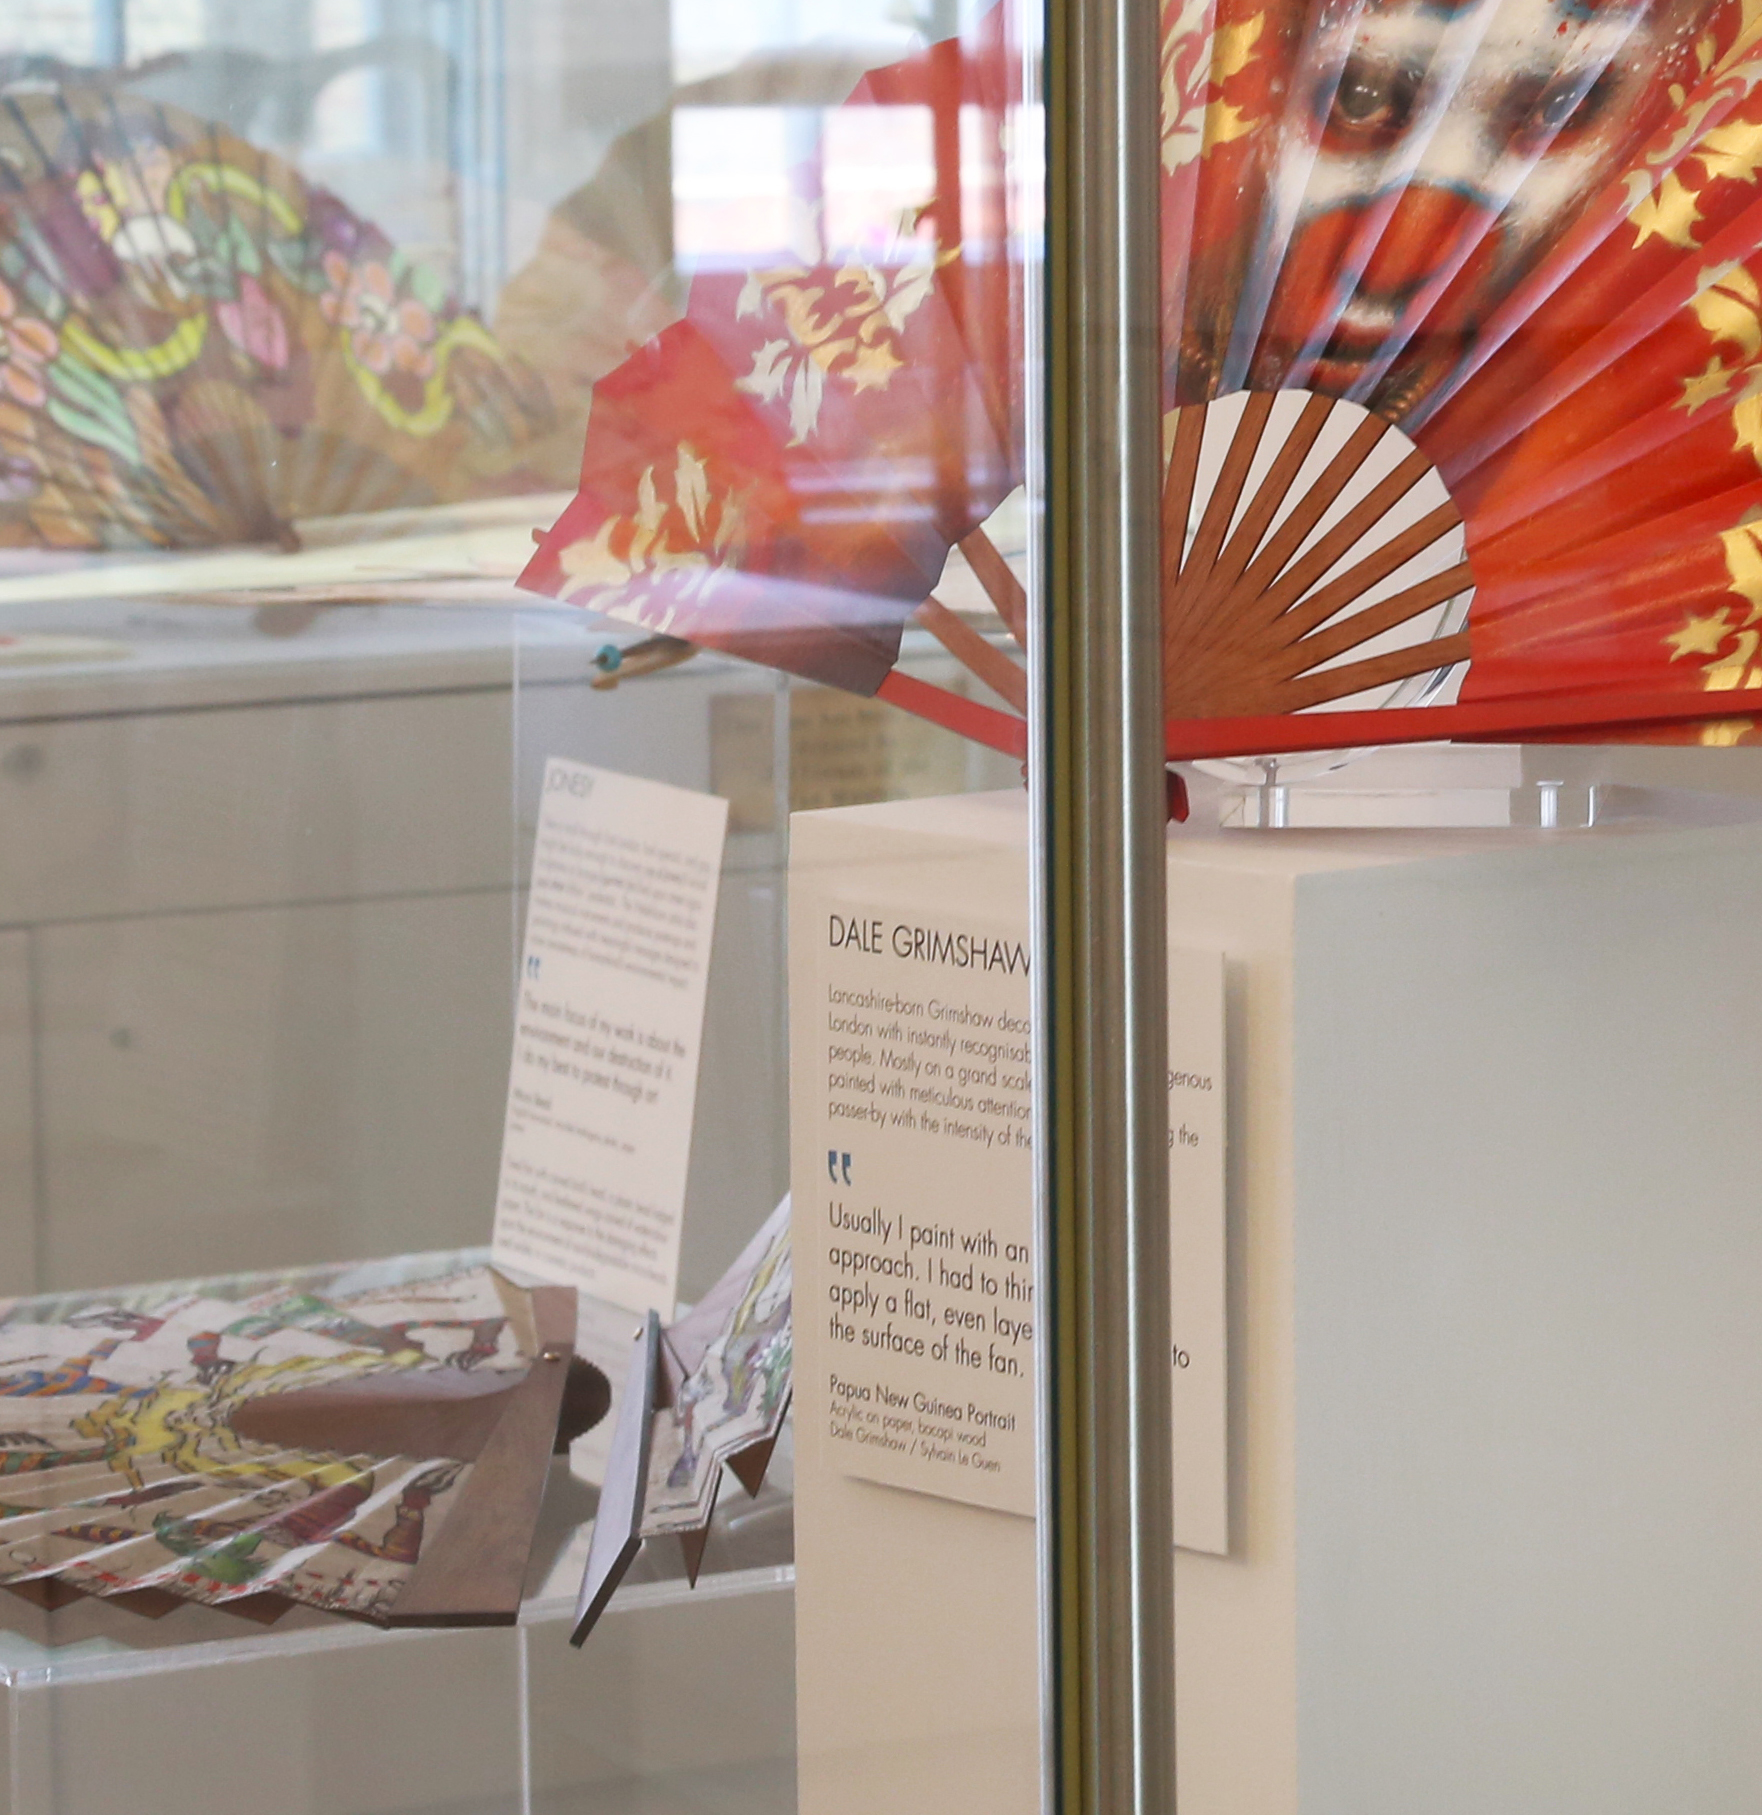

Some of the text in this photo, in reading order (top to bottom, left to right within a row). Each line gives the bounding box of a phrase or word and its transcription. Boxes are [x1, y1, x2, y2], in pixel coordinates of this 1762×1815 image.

[829, 914, 1030, 976] DALE GRIMSHAW
[828, 1011, 956, 1057] London with instantly
[927, 999, 994, 1028] Grimshaw
[879, 1048, 921, 1078] Mostly
[924, 1061, 941, 1076] on
[944, 1064, 954, 1079] a
[958, 1062, 997, 1087] grand
[828, 1072, 875, 1094] painted
[879, 1078, 905, 1098] with
[909, 1086, 974, 1111] meticulous
[1178, 1123, 1199, 1147] the
[890, 1108, 916, 1129] with
[920, 1111, 939, 1133] the
[943, 1117, 994, 1148] intensity
[997, 1124, 1011, 1145] of
[829, 1201, 1028, 1263] Usually I paint with an
[928, 1257, 932, 1283] I
[939, 1258, 973, 1291] had
[980, 1271, 998, 1296] to
[829, 1281, 879, 1317] apply
[885, 1295, 897, 1314] a
[943, 1307, 985, 1331] even
[1172, 1343, 1190, 1369] to
[829, 1313, 855, 1343] the
[862, 1323, 924, 1356] surface
[931, 1333, 948, 1361] of
[955, 1337, 981, 1369] the
[830, 1373, 1015, 1431] Papua New Guinea Portrait
